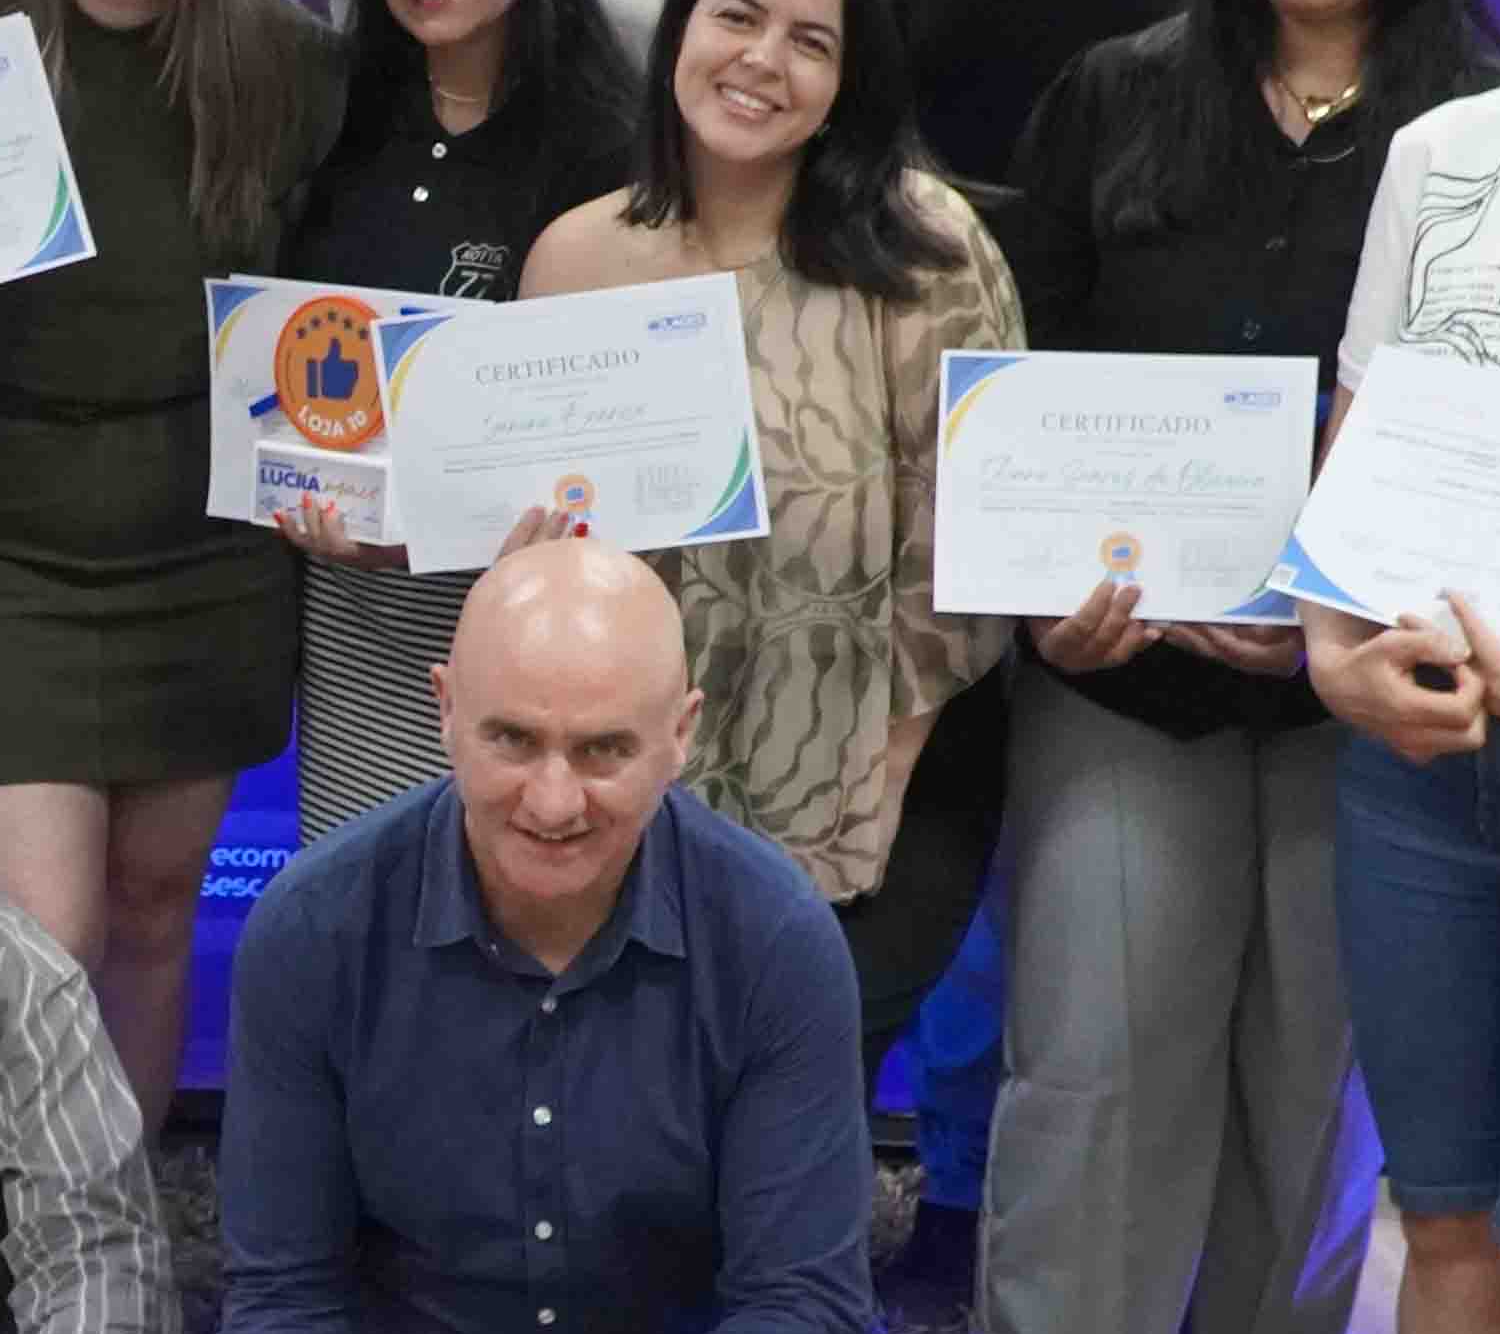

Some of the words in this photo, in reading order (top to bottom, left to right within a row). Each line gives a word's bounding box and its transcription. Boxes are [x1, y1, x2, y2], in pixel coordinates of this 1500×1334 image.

[473, 348, 641, 385] CERTIFICADO
[297, 403, 345, 437] LOJA
[345, 409, 368, 432] 10
[1040, 411, 1212, 435] CERTIFICADO
[260, 466, 320, 493] LUCRA
[208, 844, 290, 869] ecom
